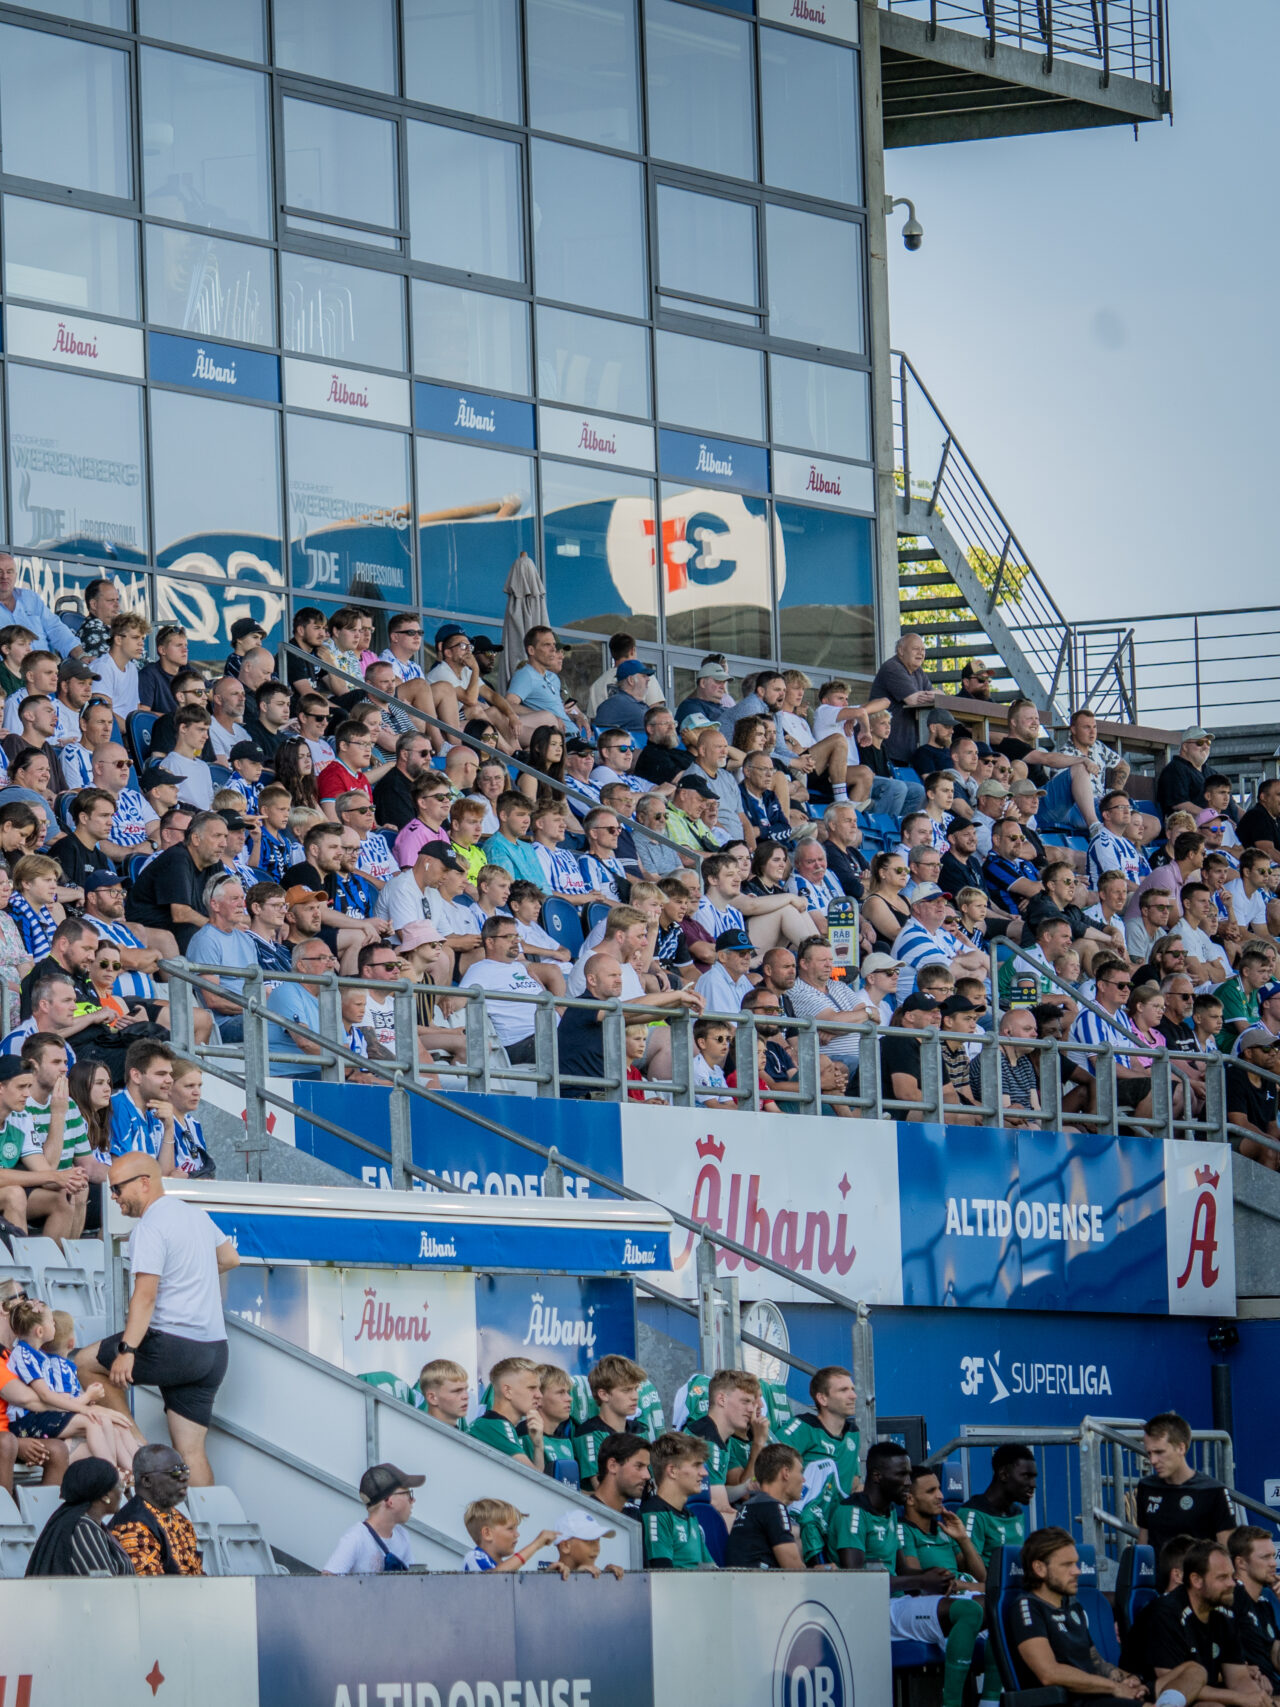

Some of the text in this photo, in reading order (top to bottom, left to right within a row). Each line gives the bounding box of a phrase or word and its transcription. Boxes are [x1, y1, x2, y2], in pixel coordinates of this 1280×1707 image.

[52, 325, 98, 359] Albani
[192, 351, 237, 385] Albani
[327, 376, 369, 409] Albani
[454, 401, 496, 433] Albani
[577, 424, 617, 455] Albani
[695, 446, 734, 477] Albani
[806, 466, 842, 497] Albani
[304, 548, 406, 590] JDE PROFESSIONAL
[673, 1162, 857, 1277] Albani
[946, 1197, 1105, 1242] ALTID ODENSE
[418, 1232, 457, 1259] Albani
[355, 1294, 432, 1343] Albani
[523, 1300, 597, 1347] Albani
[960, 1355, 1113, 1396] 3F SUPERLIGA
